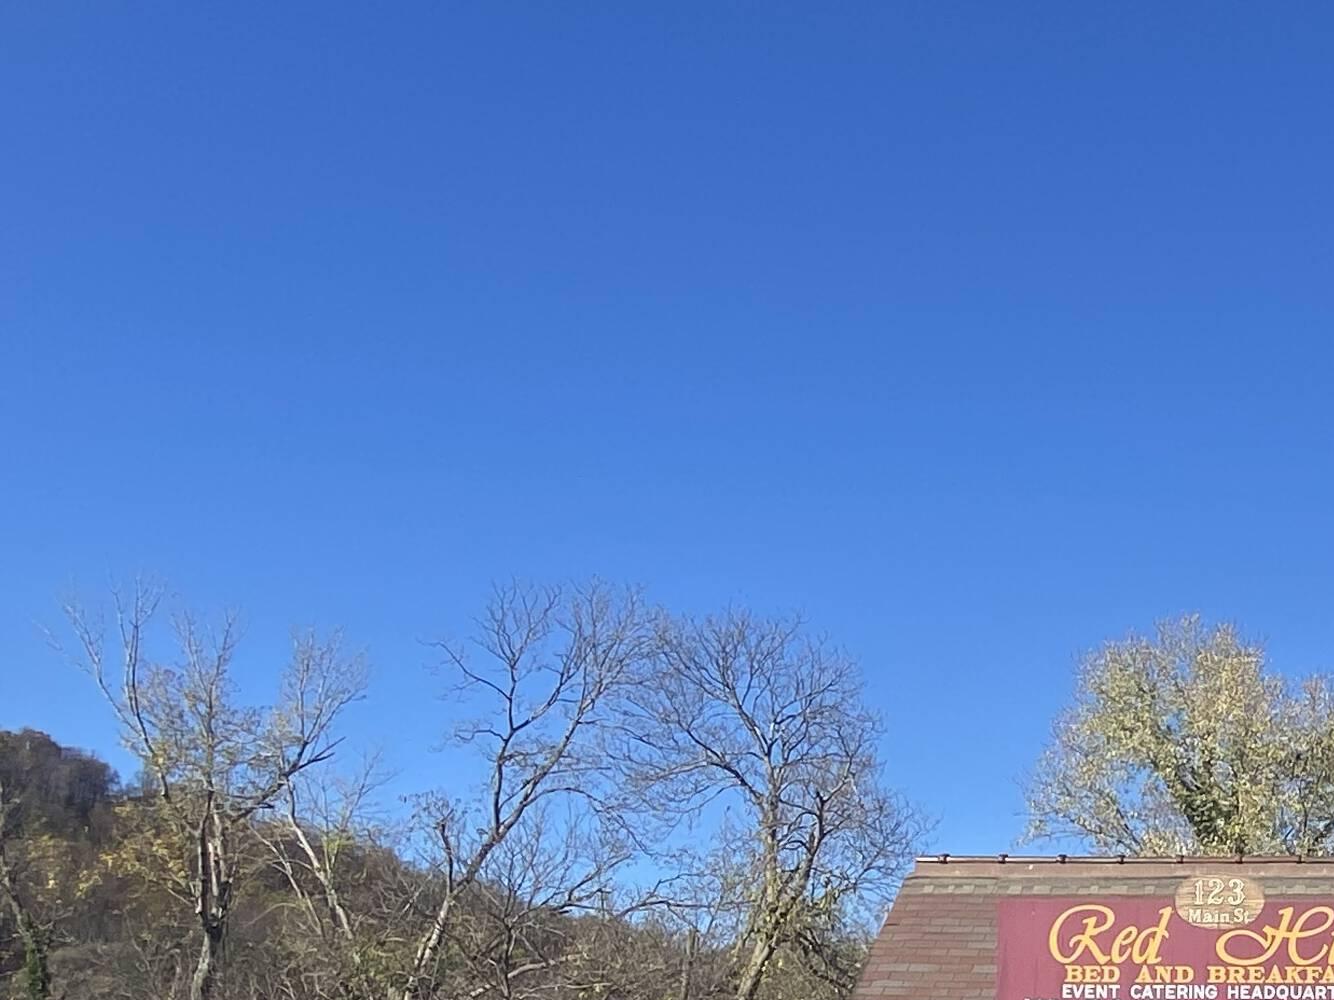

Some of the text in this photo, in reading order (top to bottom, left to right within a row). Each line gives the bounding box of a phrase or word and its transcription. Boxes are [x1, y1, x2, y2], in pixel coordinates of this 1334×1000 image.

[1194, 878, 1245, 906] 123
[1188, 907, 1250, 924] Main St
[1049, 904, 1174, 965] Red
[1064, 964, 1121, 983] BED
[1134, 964, 1195, 983] AND
[1061, 983, 1121, 999] EVENT
[1130, 984, 1218, 1000] CATERING
